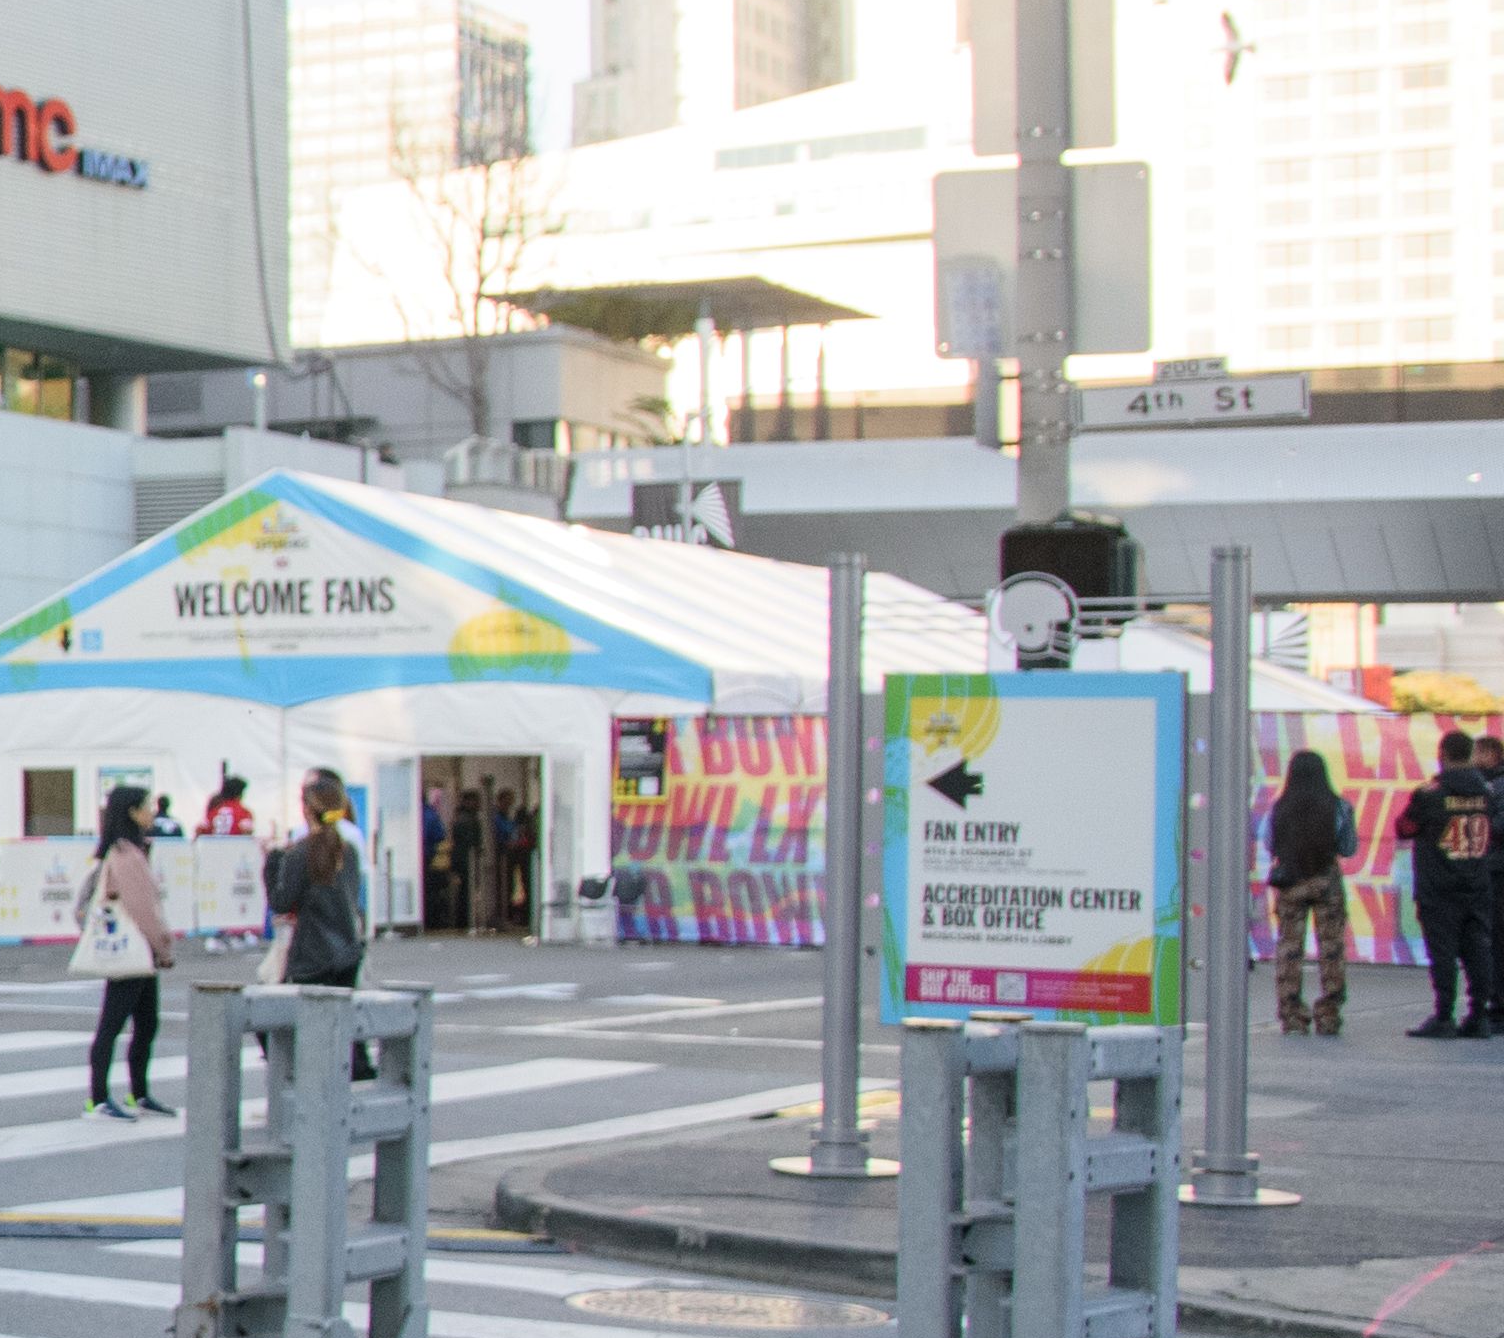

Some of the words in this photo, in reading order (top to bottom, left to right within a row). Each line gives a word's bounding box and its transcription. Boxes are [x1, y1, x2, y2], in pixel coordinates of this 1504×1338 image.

[1127, 390, 1184, 415] 4th
[1214, 385, 1255, 412] St
[174, 577, 311, 619] WELCOME
[323, 575, 397, 617] FANS
[923, 820, 957, 842] FAN
[963, 821, 1021, 843] ENTRY
[1438, 814, 1490, 861] 49
[921, 884, 1064, 909] ACCREDITATION
[1069, 888, 1142, 912] CENTER
[922, 907, 935, 927] &
[941, 908, 976, 928] BOX
[982, 908, 1045, 931] OFFICE
[919, 967, 949, 983] SKIP
[951, 969, 974, 984] THE
[919, 982, 945, 999] BOX
[945, 984, 990, 1001] OFFICE!
